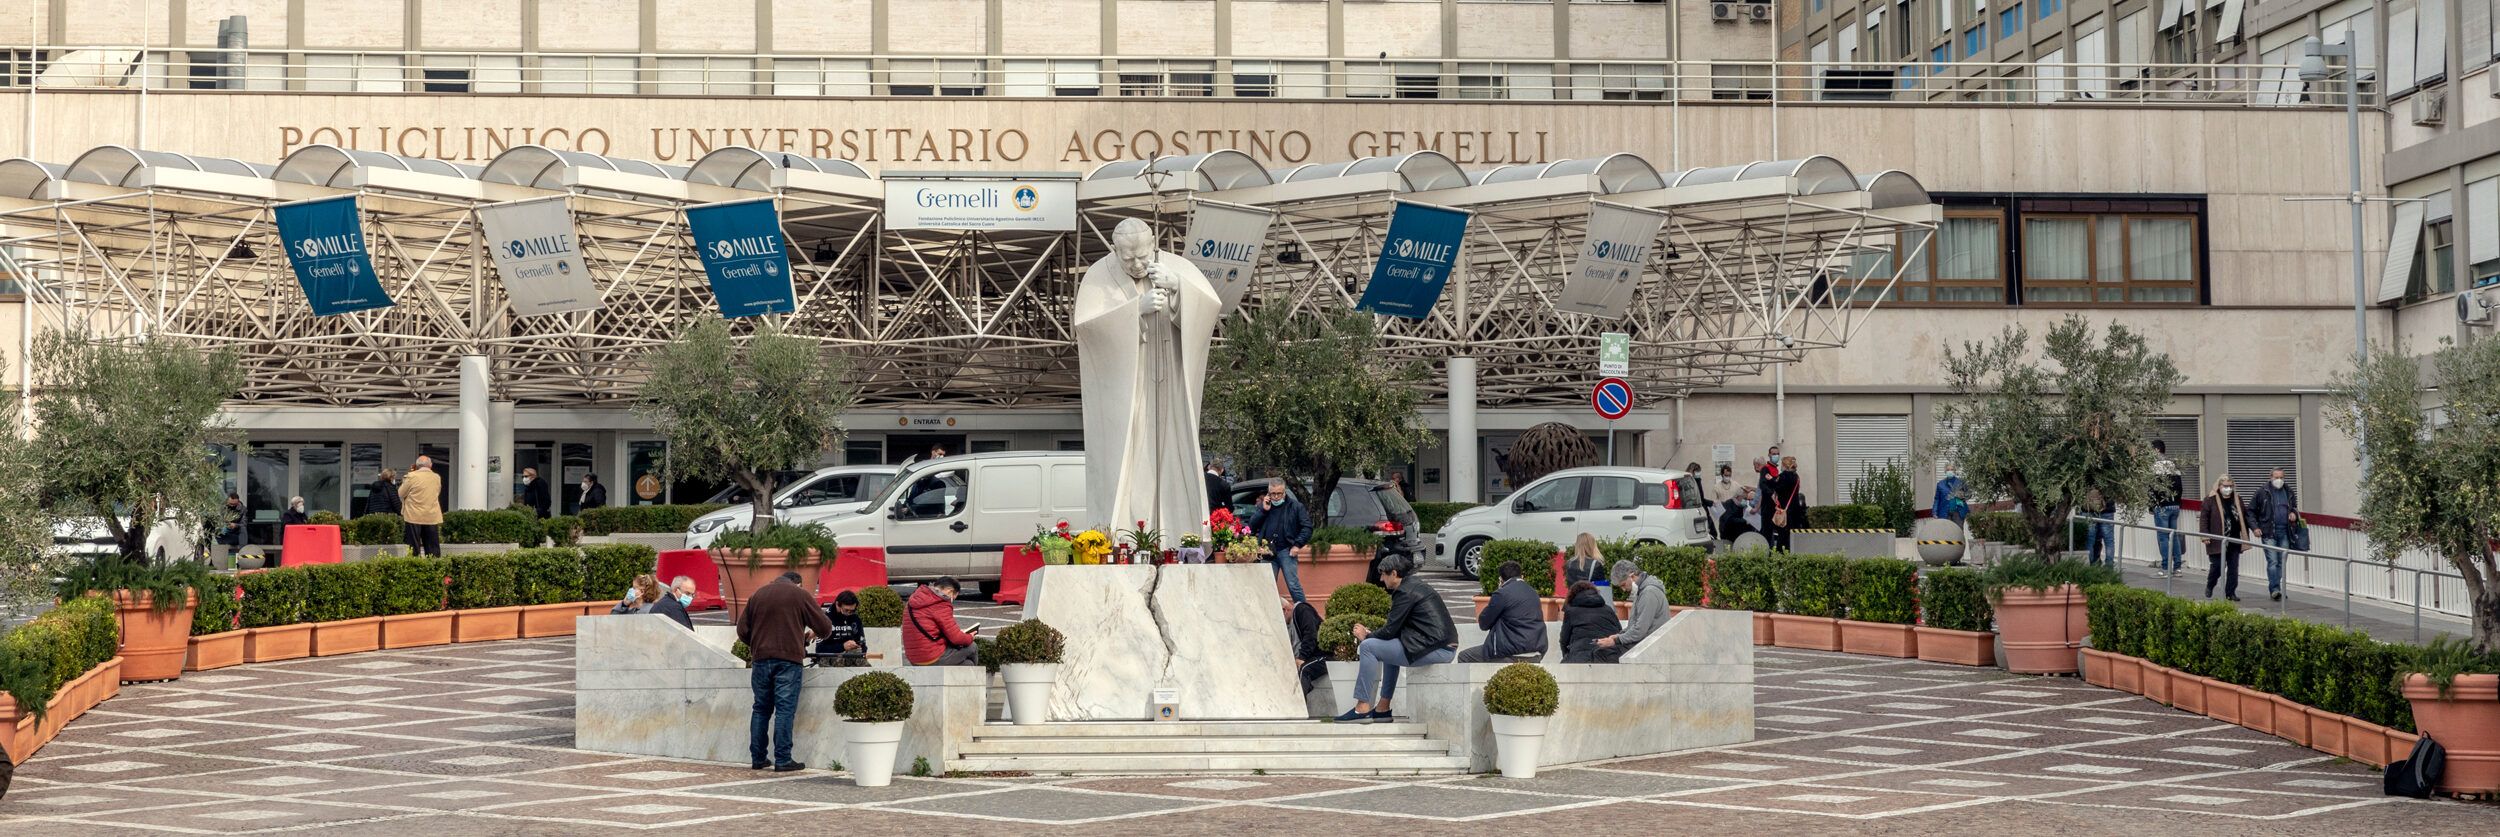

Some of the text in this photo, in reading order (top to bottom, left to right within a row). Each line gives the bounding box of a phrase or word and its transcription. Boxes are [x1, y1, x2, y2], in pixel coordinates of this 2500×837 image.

[279, 126, 1549, 164] POLICLINICO UNIVERSITARIO AGOSTINO GEMELLI
[916, 187, 998, 208] Gemelli
[308, 263, 345, 278] Gemelli
[515, 264, 554, 279] Gemelli
[721, 264, 762, 279] Gemelli
[1387, 264, 1421, 279] Gemelli
[1584, 265, 1616, 280] Gemelli
